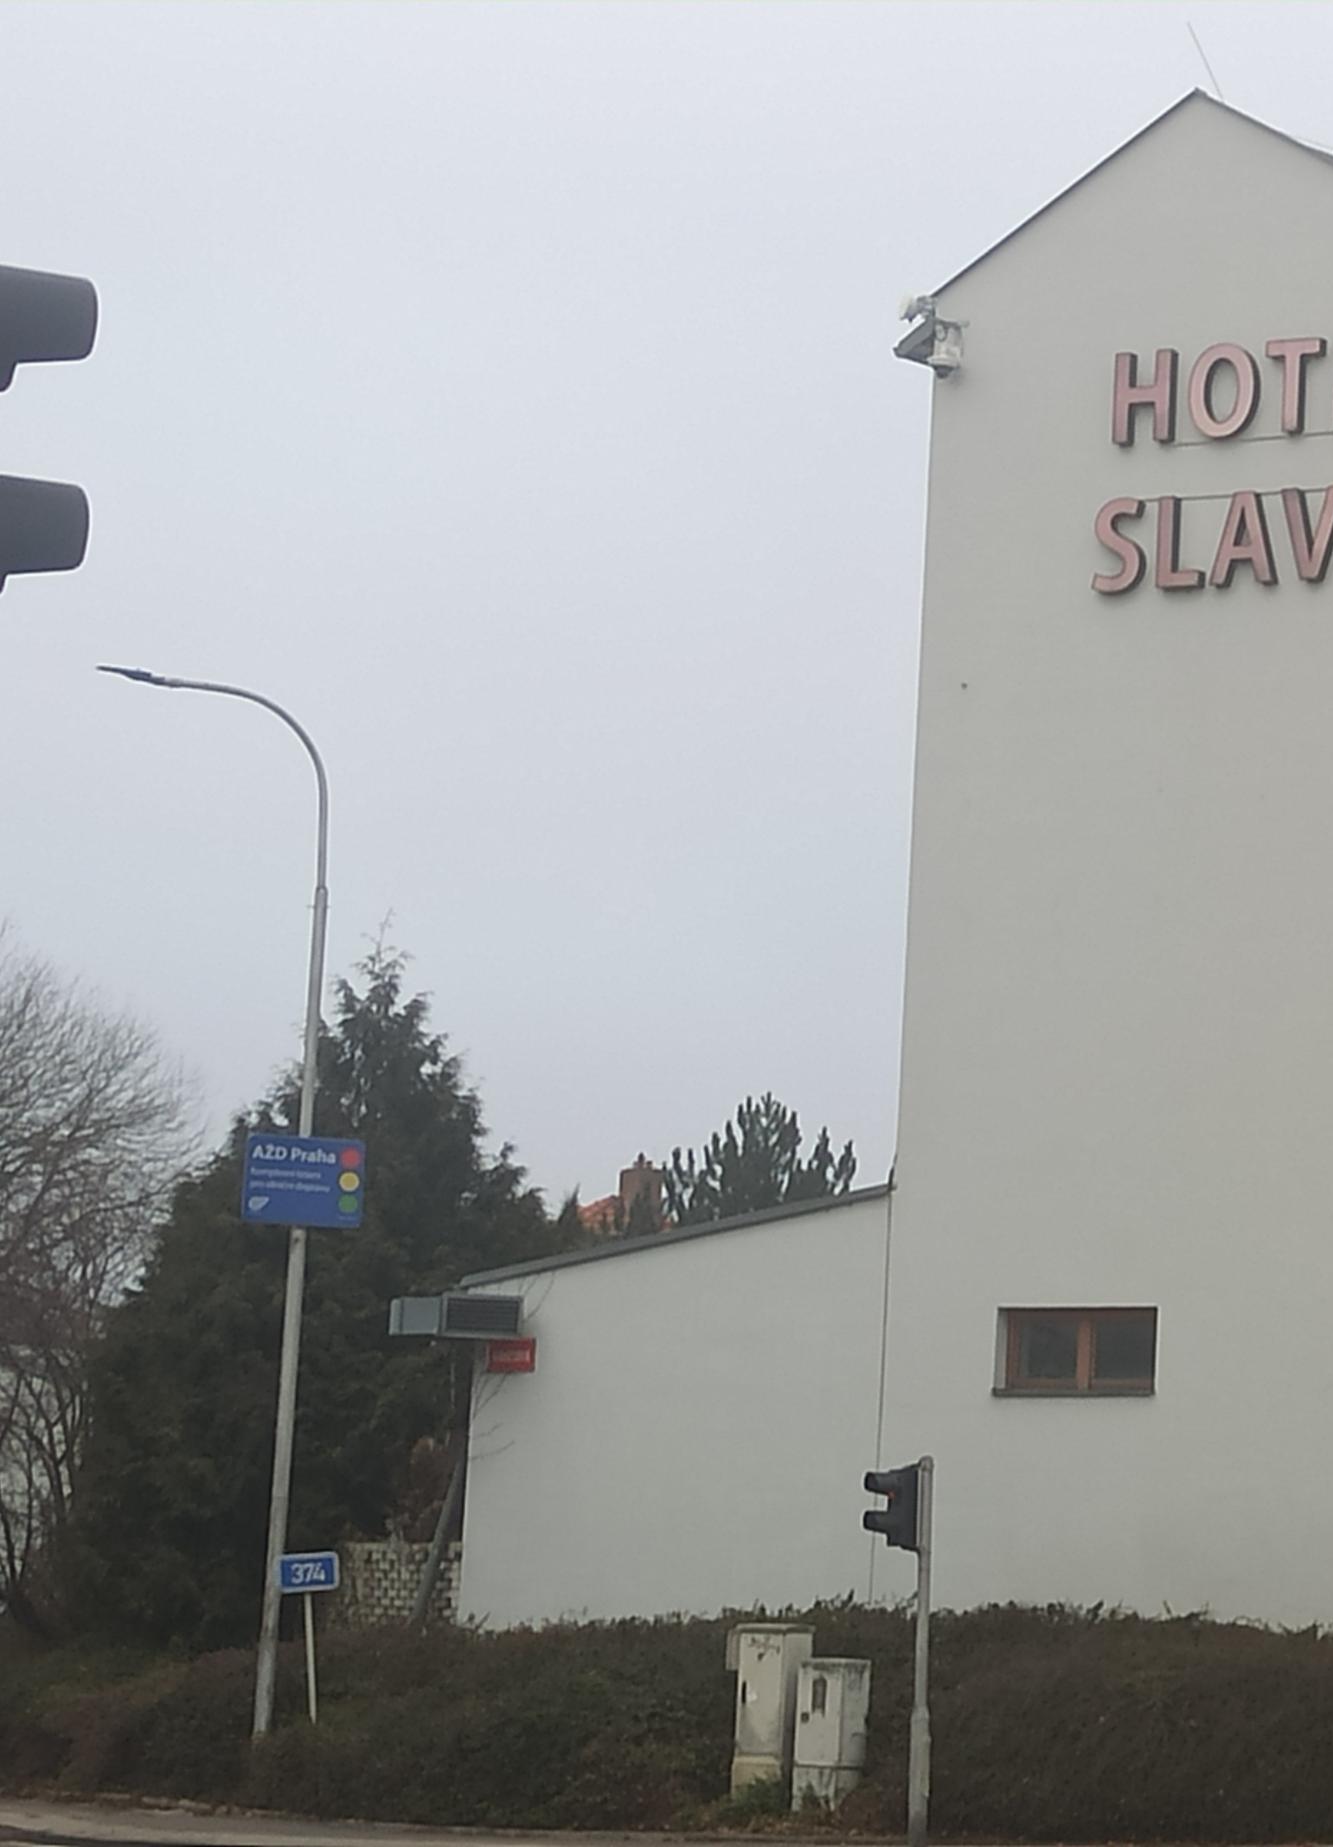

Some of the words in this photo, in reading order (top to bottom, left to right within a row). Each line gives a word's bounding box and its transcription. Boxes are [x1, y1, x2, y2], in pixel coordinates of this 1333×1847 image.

[252, 1144, 288, 1161] AŽD
[290, 1147, 337, 1165] Praha
[291, 1562, 326, 1585] 374
